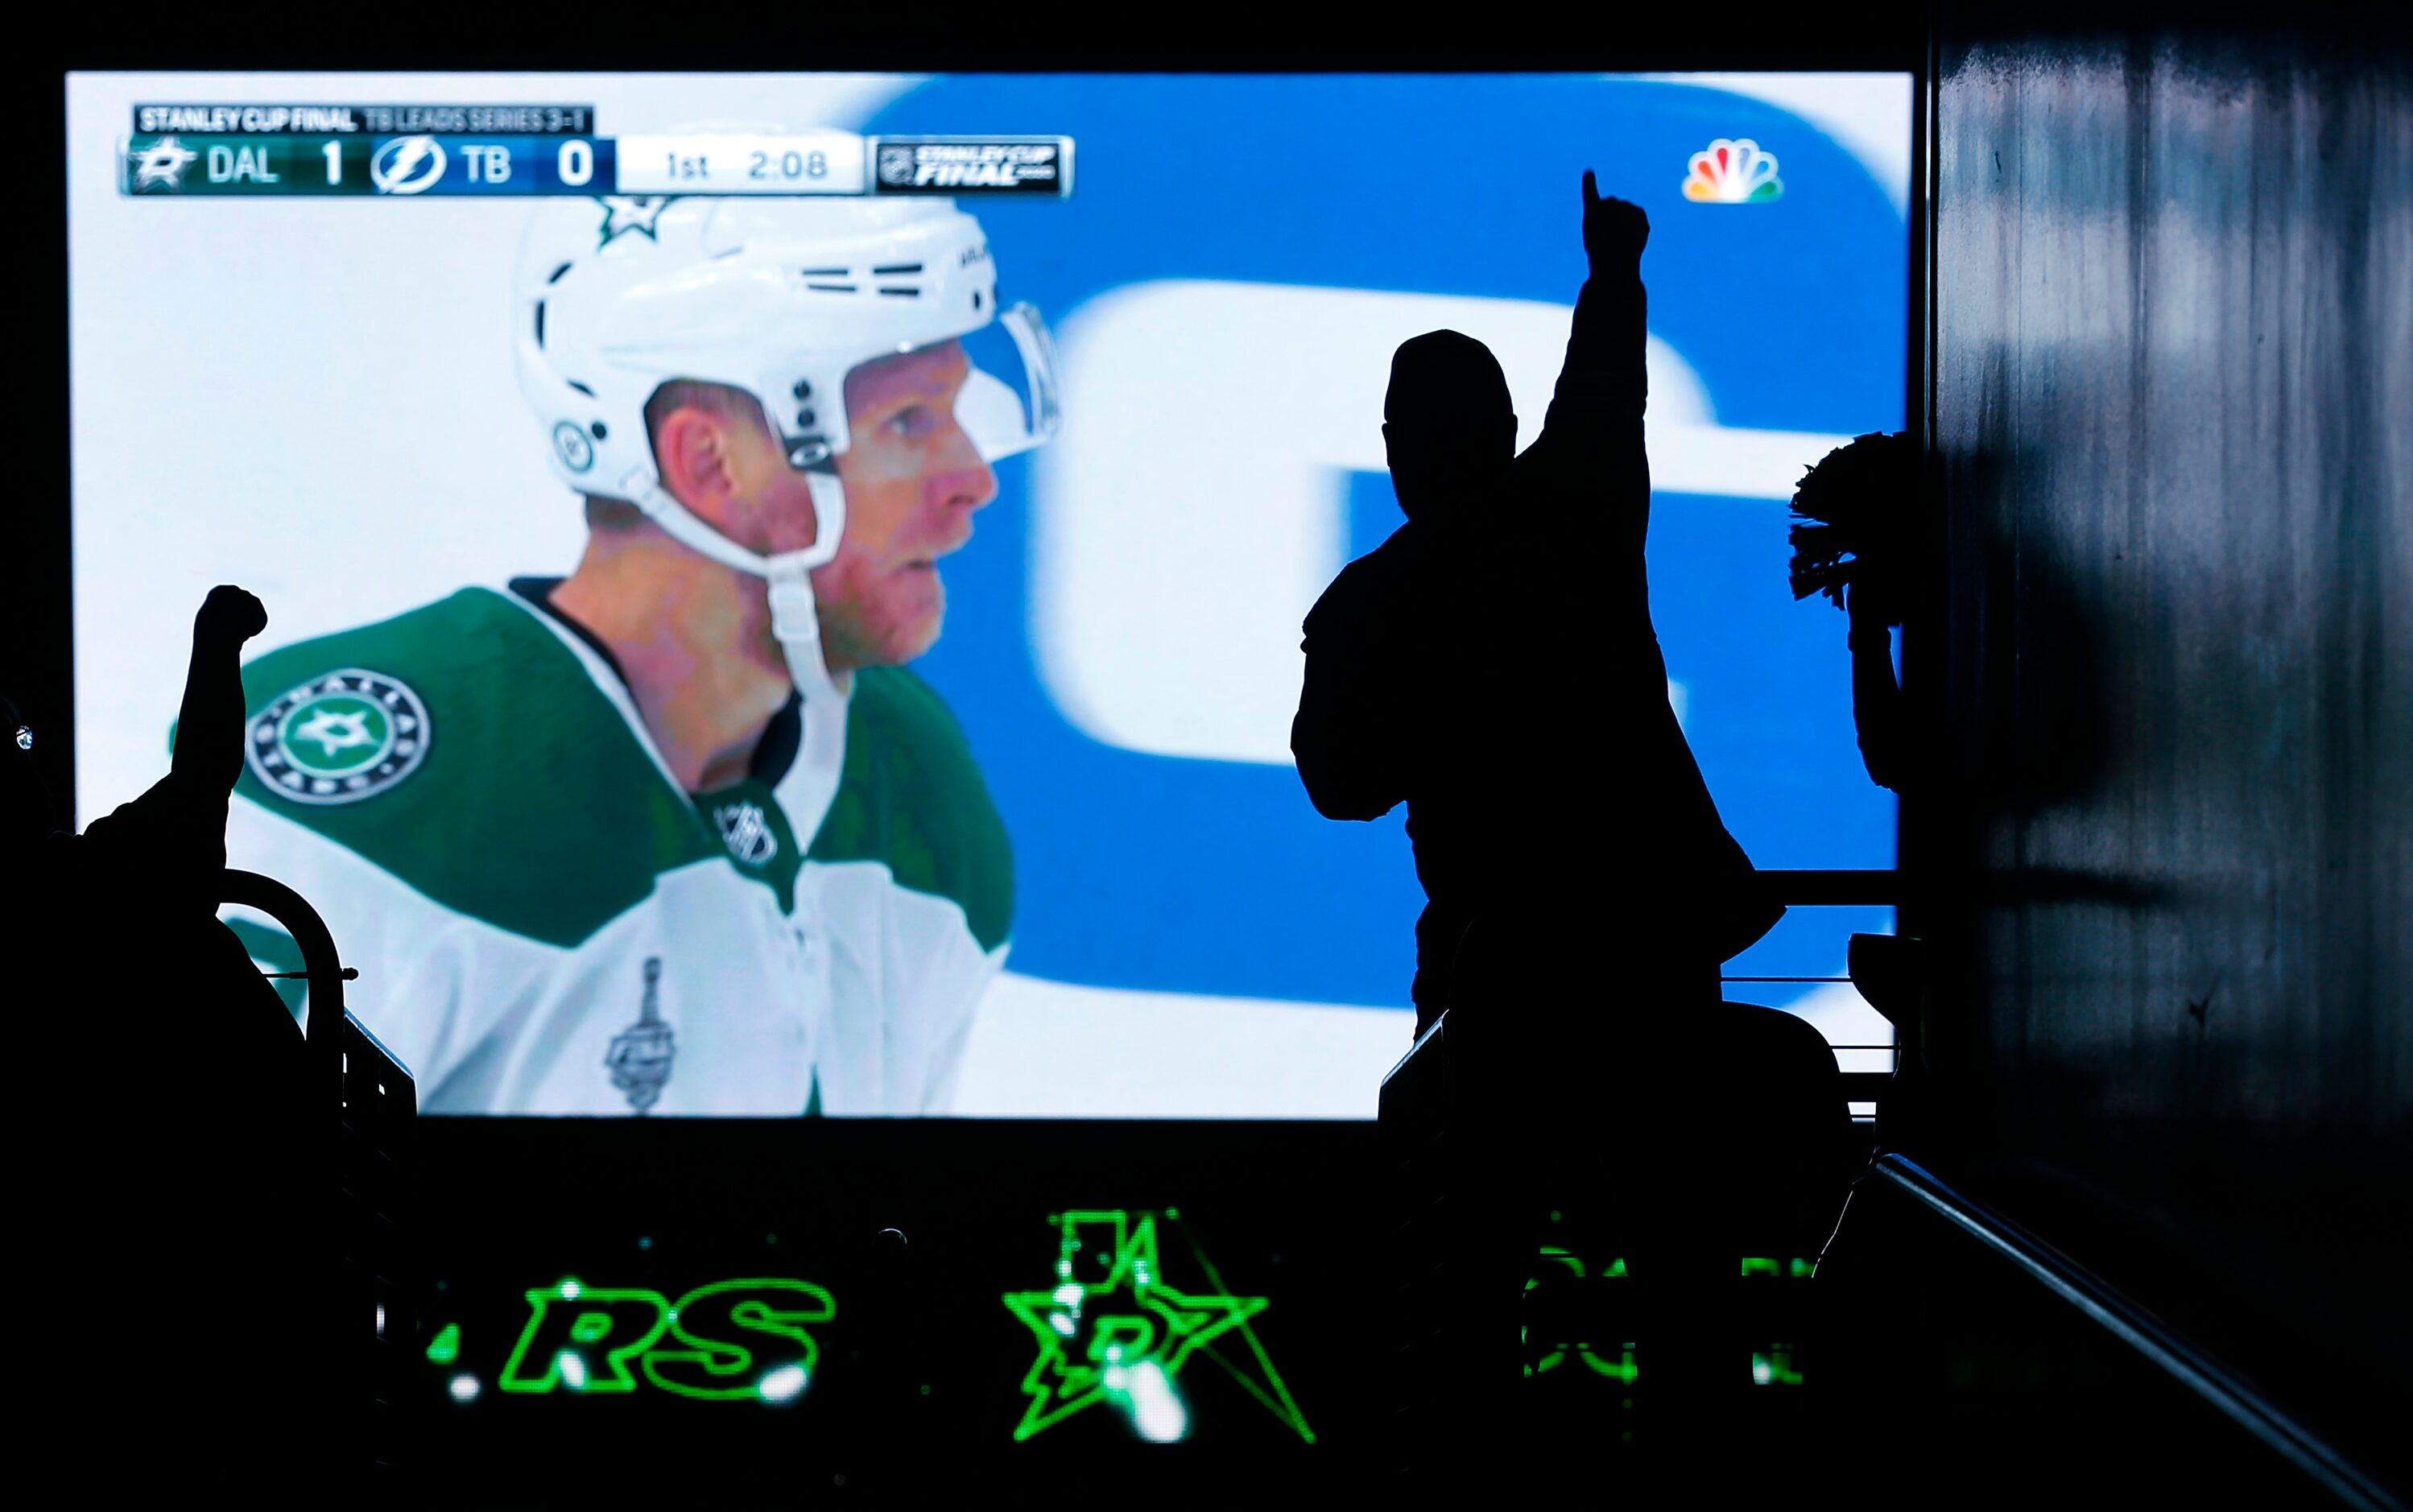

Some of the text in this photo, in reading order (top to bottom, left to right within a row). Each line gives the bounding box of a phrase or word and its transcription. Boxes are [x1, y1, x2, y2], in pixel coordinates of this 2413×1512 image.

[139, 106, 358, 132] STANLEY CUP FINAL
[365, 107, 585, 132] TB LEADS SERIES 3-1
[207, 140, 342, 186] DAL 1
[460, 139, 594, 186] TB 0
[667, 151, 829, 180] 1st 2:08
[915, 145, 1056, 164] STANLEY CUP
[914, 163, 1020, 187] FINAL
